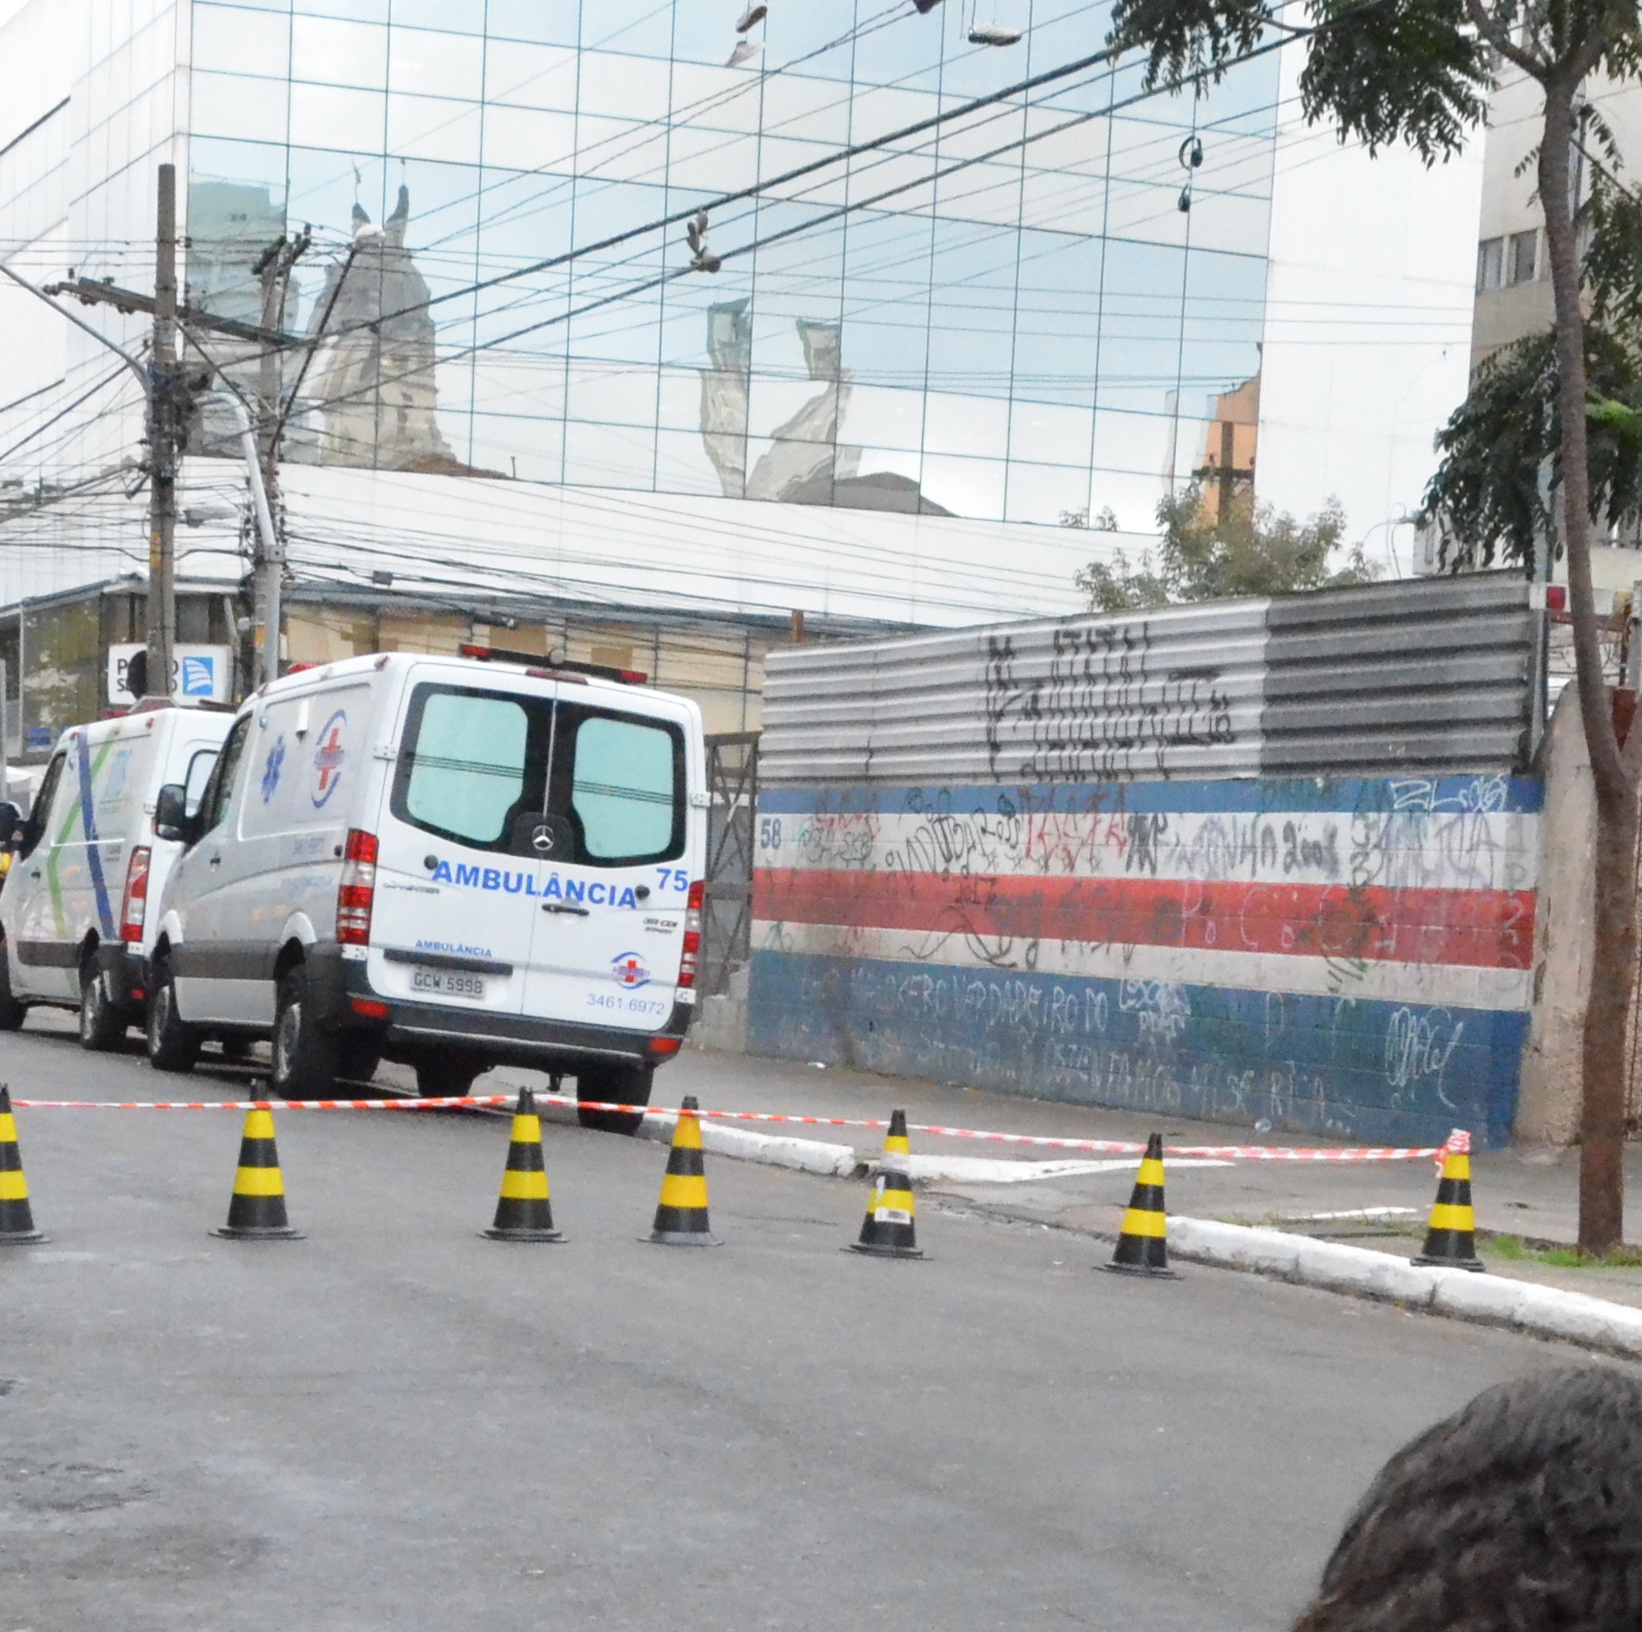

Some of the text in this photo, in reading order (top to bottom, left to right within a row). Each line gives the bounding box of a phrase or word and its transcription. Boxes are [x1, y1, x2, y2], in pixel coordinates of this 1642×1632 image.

[760, 818, 782, 850] 58
[432, 860, 637, 909] AMBULÂNCIA
[656, 867, 689, 891] 75
[414, 972, 484, 995] GCW 5998
